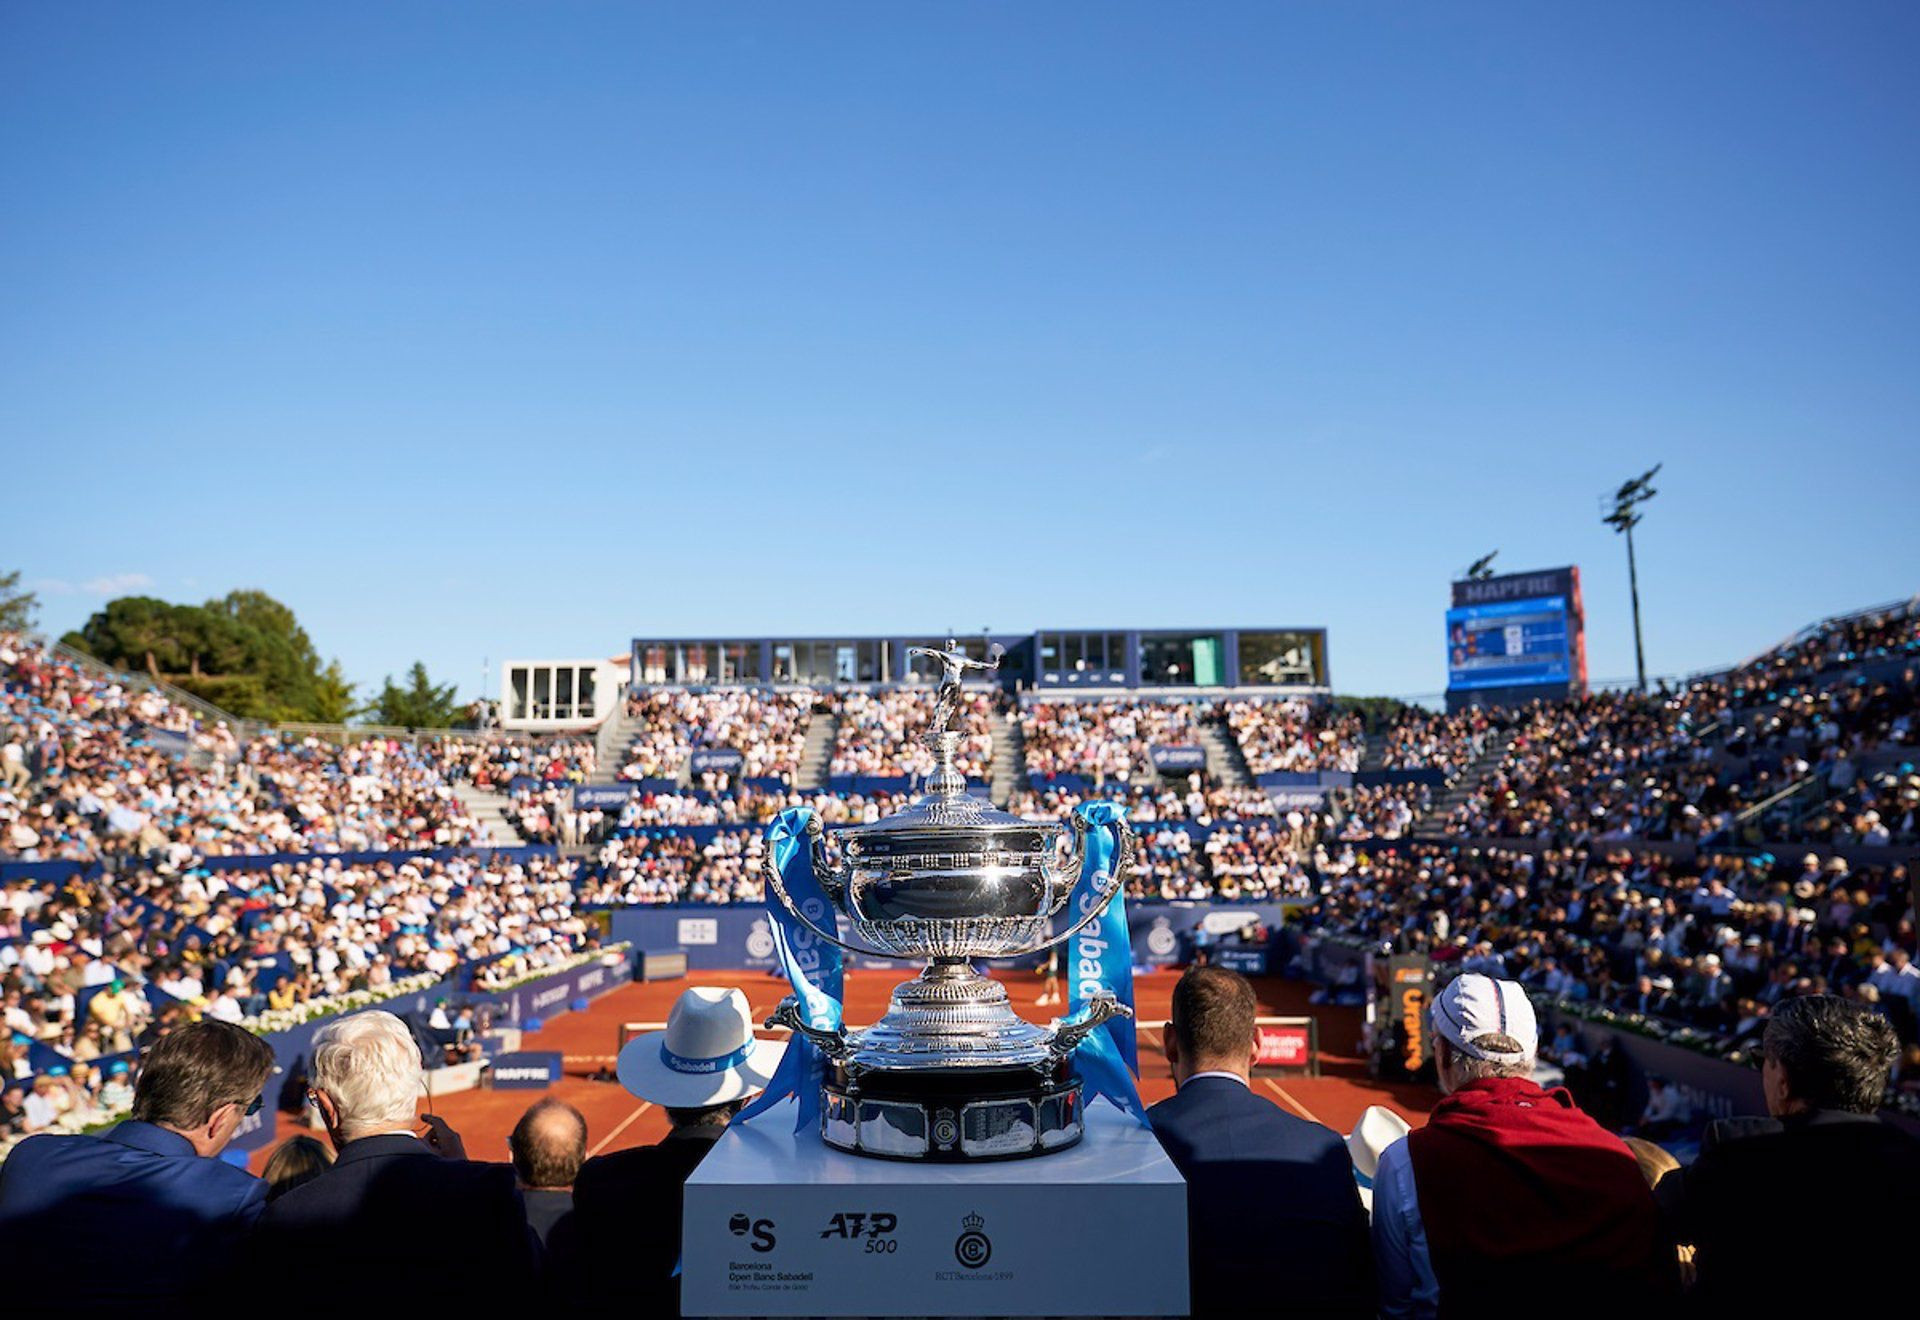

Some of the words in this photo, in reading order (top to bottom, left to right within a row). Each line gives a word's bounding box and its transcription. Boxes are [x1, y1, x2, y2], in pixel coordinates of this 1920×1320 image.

[1465, 575, 1557, 600] MAPFRE
[1079, 891, 1110, 1001] Sabad
[494, 1067, 549, 1080] MAPFRE
[818, 1212, 898, 1239] ATP
[864, 1239, 898, 1254] 500
[729, 1262, 772, 1271] Barcelona
[729, 1272, 751, 1282] Open
[753, 1272, 776, 1281] Banc
[777, 1272, 814, 1281] Sabadell
